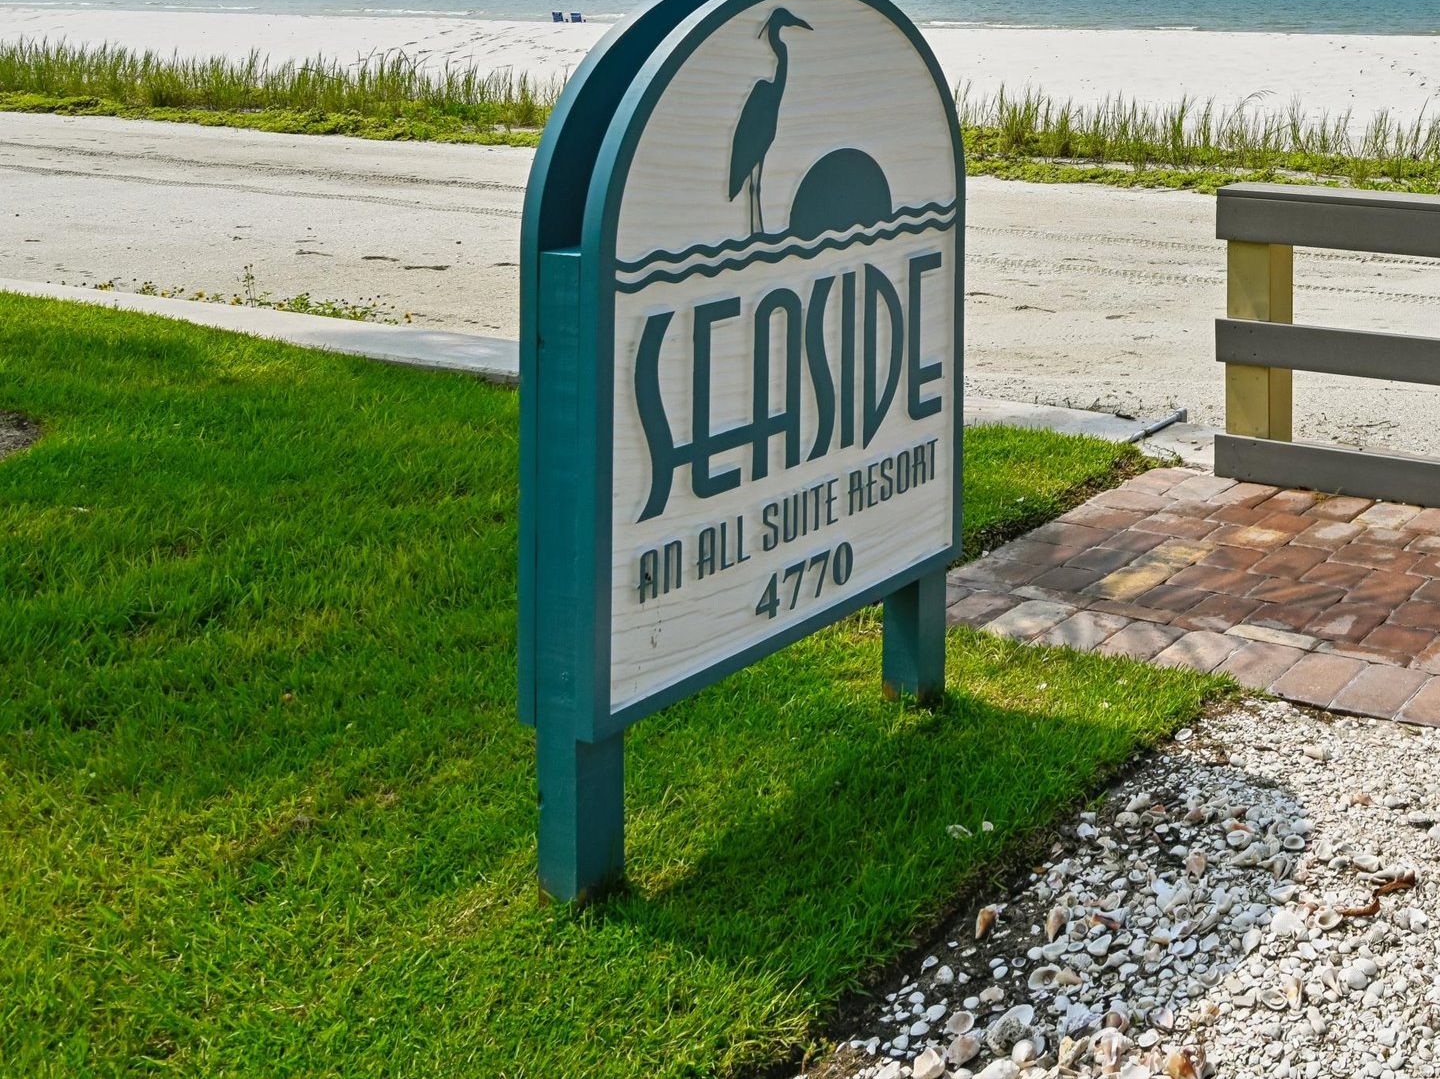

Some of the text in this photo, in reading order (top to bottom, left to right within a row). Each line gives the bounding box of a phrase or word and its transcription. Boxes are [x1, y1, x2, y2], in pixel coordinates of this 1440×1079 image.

[635, 252, 942, 524] SEASIDE
[638, 438, 939, 604] AN ALL SUITE RESORT
[755, 541, 854, 620] 4770
